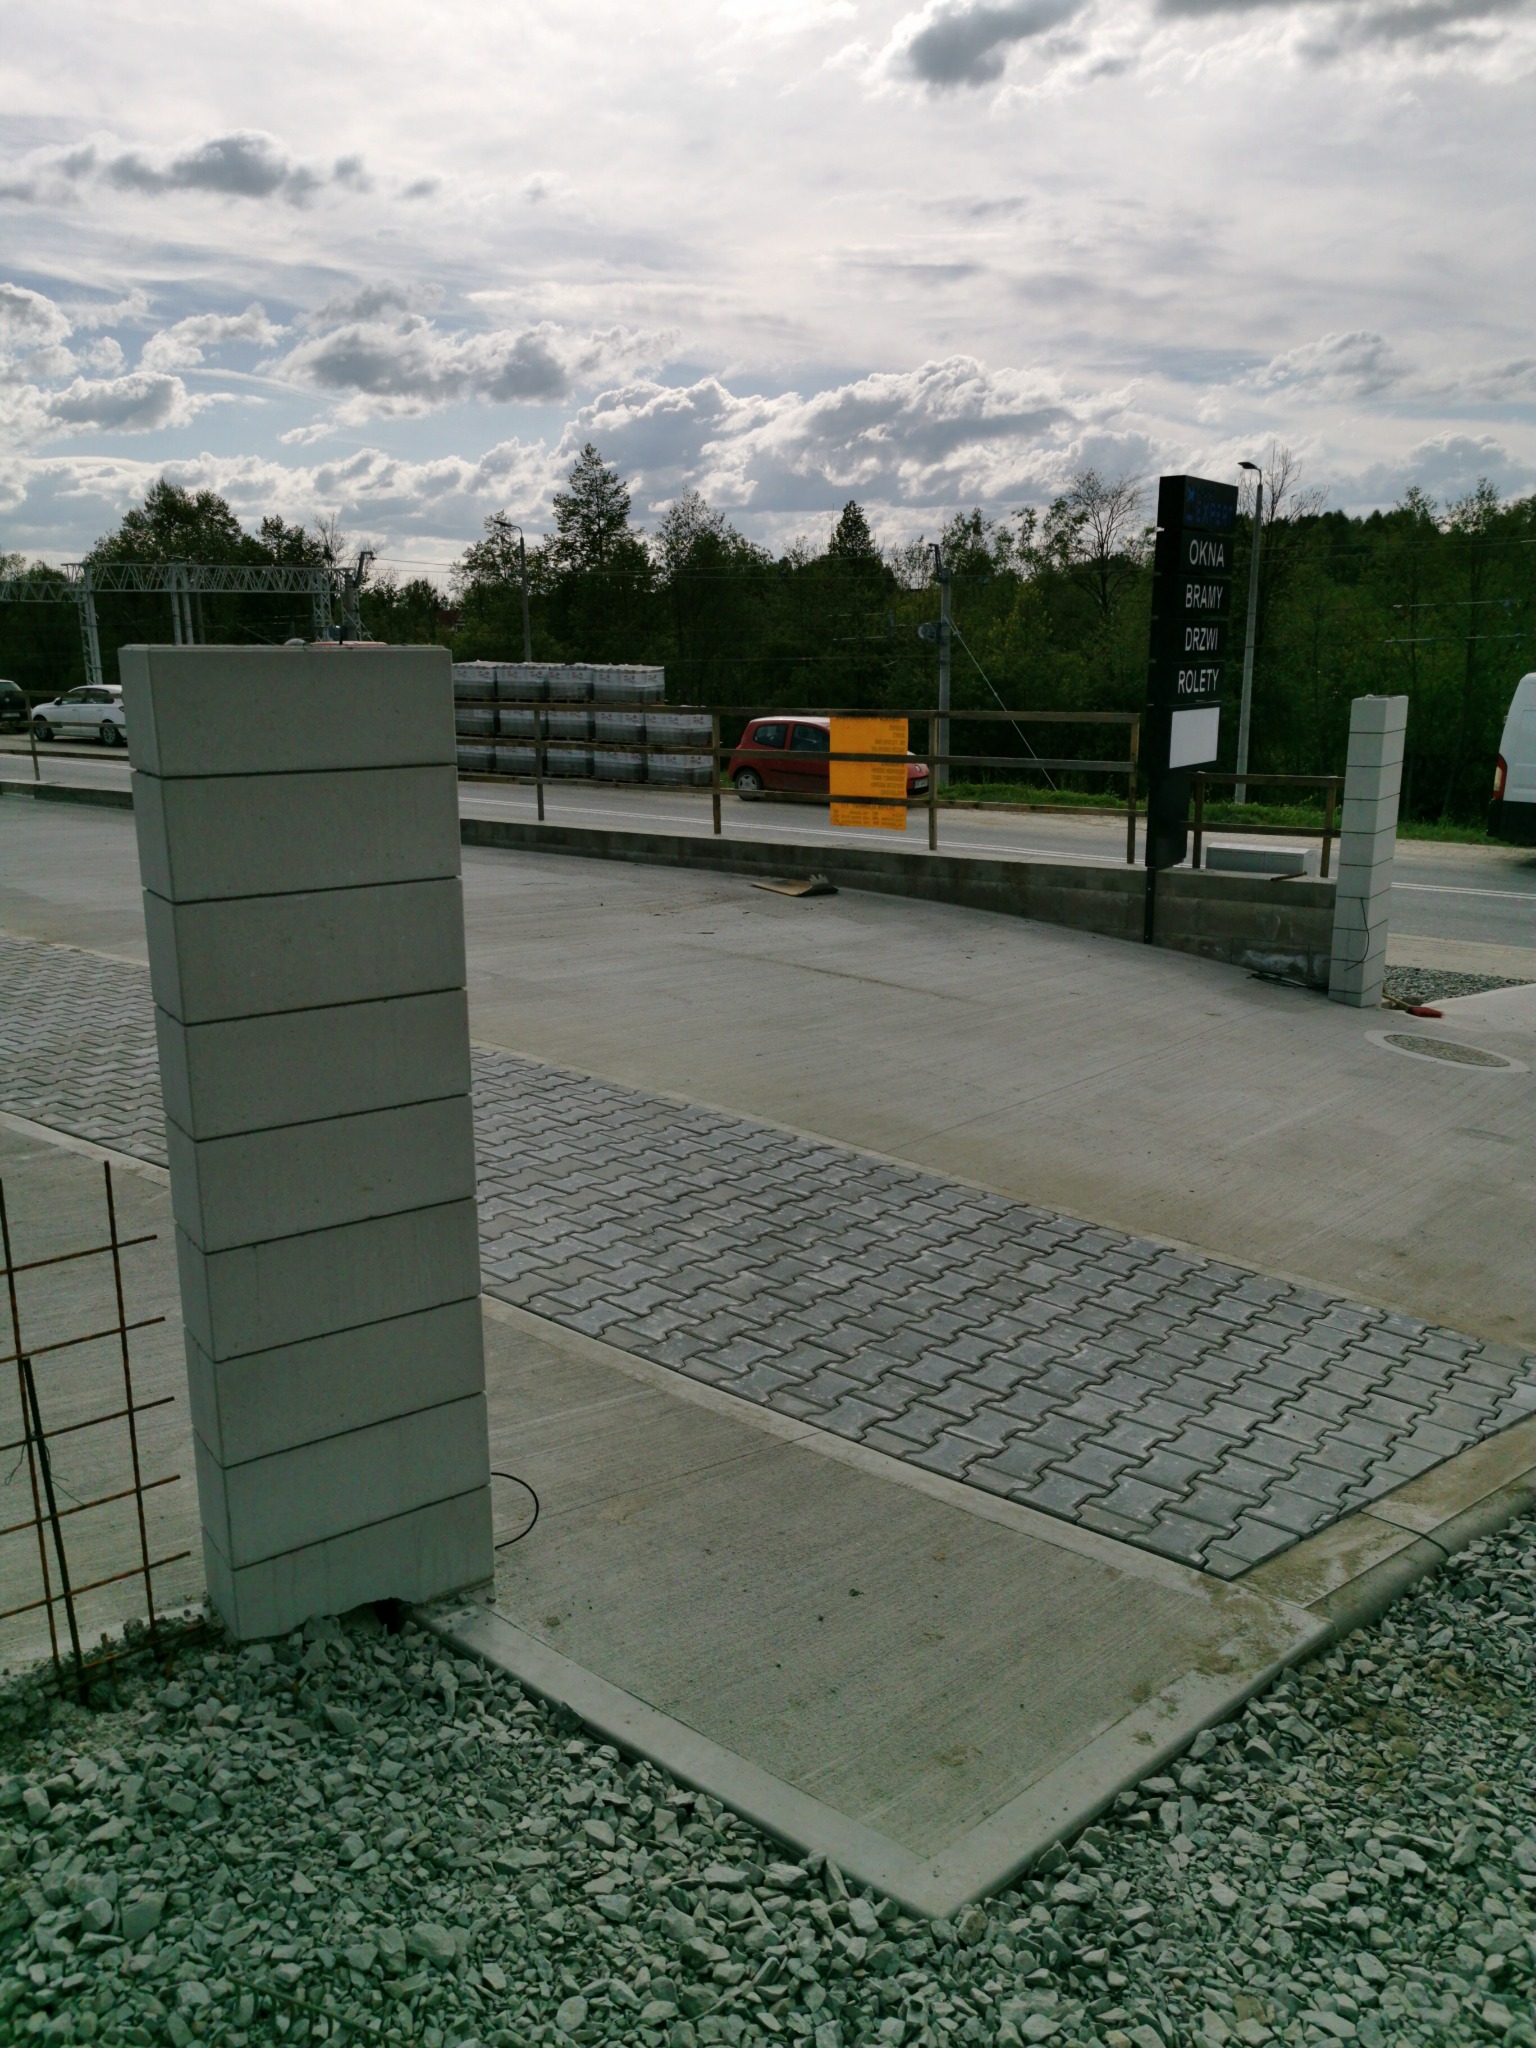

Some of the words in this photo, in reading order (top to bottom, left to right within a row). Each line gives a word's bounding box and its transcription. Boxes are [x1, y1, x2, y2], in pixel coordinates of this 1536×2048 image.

[1189, 539, 1224, 568] OKNA
[1185, 584, 1223, 608] BRAMY
[1185, 627, 1218, 651] DRZWI
[1178, 669, 1219, 694] ROLETY
